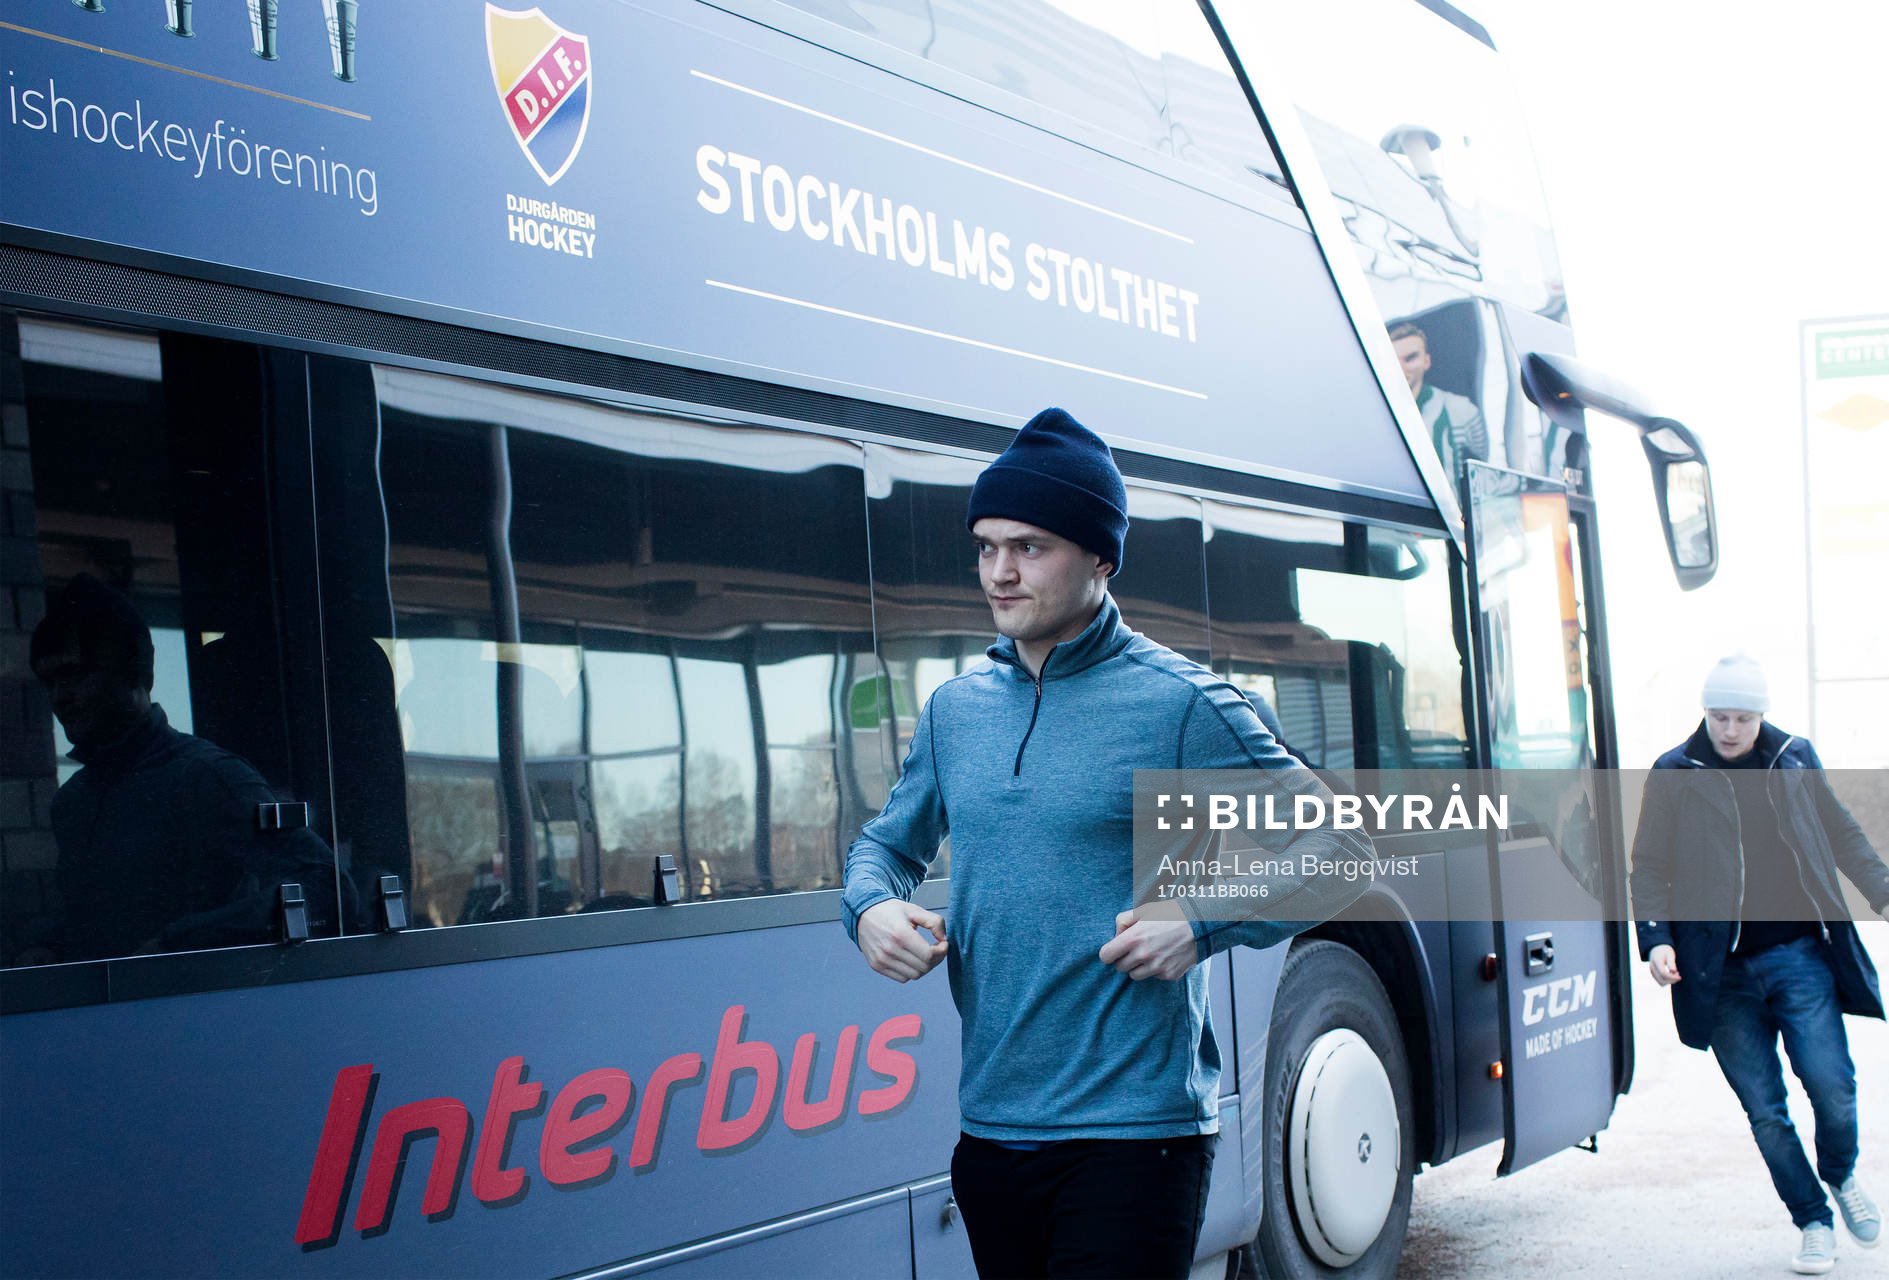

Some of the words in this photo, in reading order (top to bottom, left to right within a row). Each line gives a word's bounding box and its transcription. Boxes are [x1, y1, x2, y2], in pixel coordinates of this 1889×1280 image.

[8, 70, 379, 217] ishockeyförening
[506, 193, 596, 230] DJURGÅRDEN
[507, 214, 597, 259] HOCKEY
[695, 144, 1015, 292] STOCKHOLMS
[1024, 243, 1200, 343] STOLTHET
[1522, 970, 1597, 1026] CCM
[1525, 1032, 1551, 1059] MADE
[1551, 1028, 1564, 1050] OF
[1565, 1017, 1598, 1046] HOCKEY
[293, 1004, 924, 1249] Interbus
